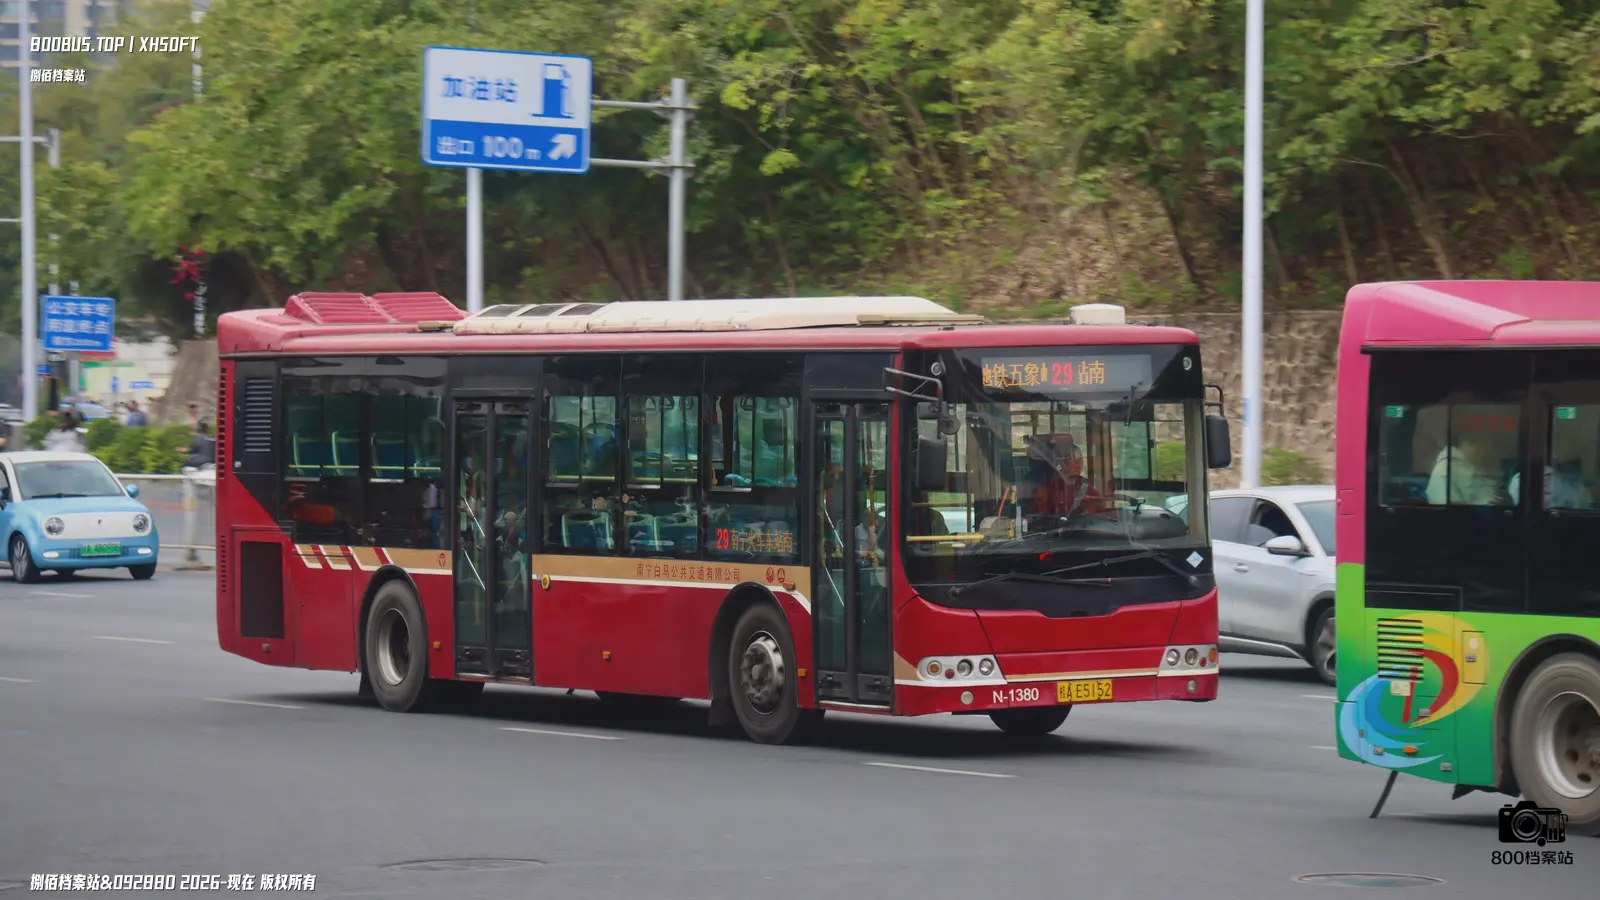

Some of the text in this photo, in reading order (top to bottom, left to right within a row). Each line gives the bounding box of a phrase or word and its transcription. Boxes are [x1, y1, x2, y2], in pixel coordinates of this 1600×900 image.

[441, 75, 518, 103] 加油站
[436, 136, 475, 156] 出口
[1051, 361, 1075, 386] 29
[715, 528, 729, 550] 29
[636, 563, 741, 582] 南宁白马公共交通有限公司
[992, 687, 1040, 704] N-1380
